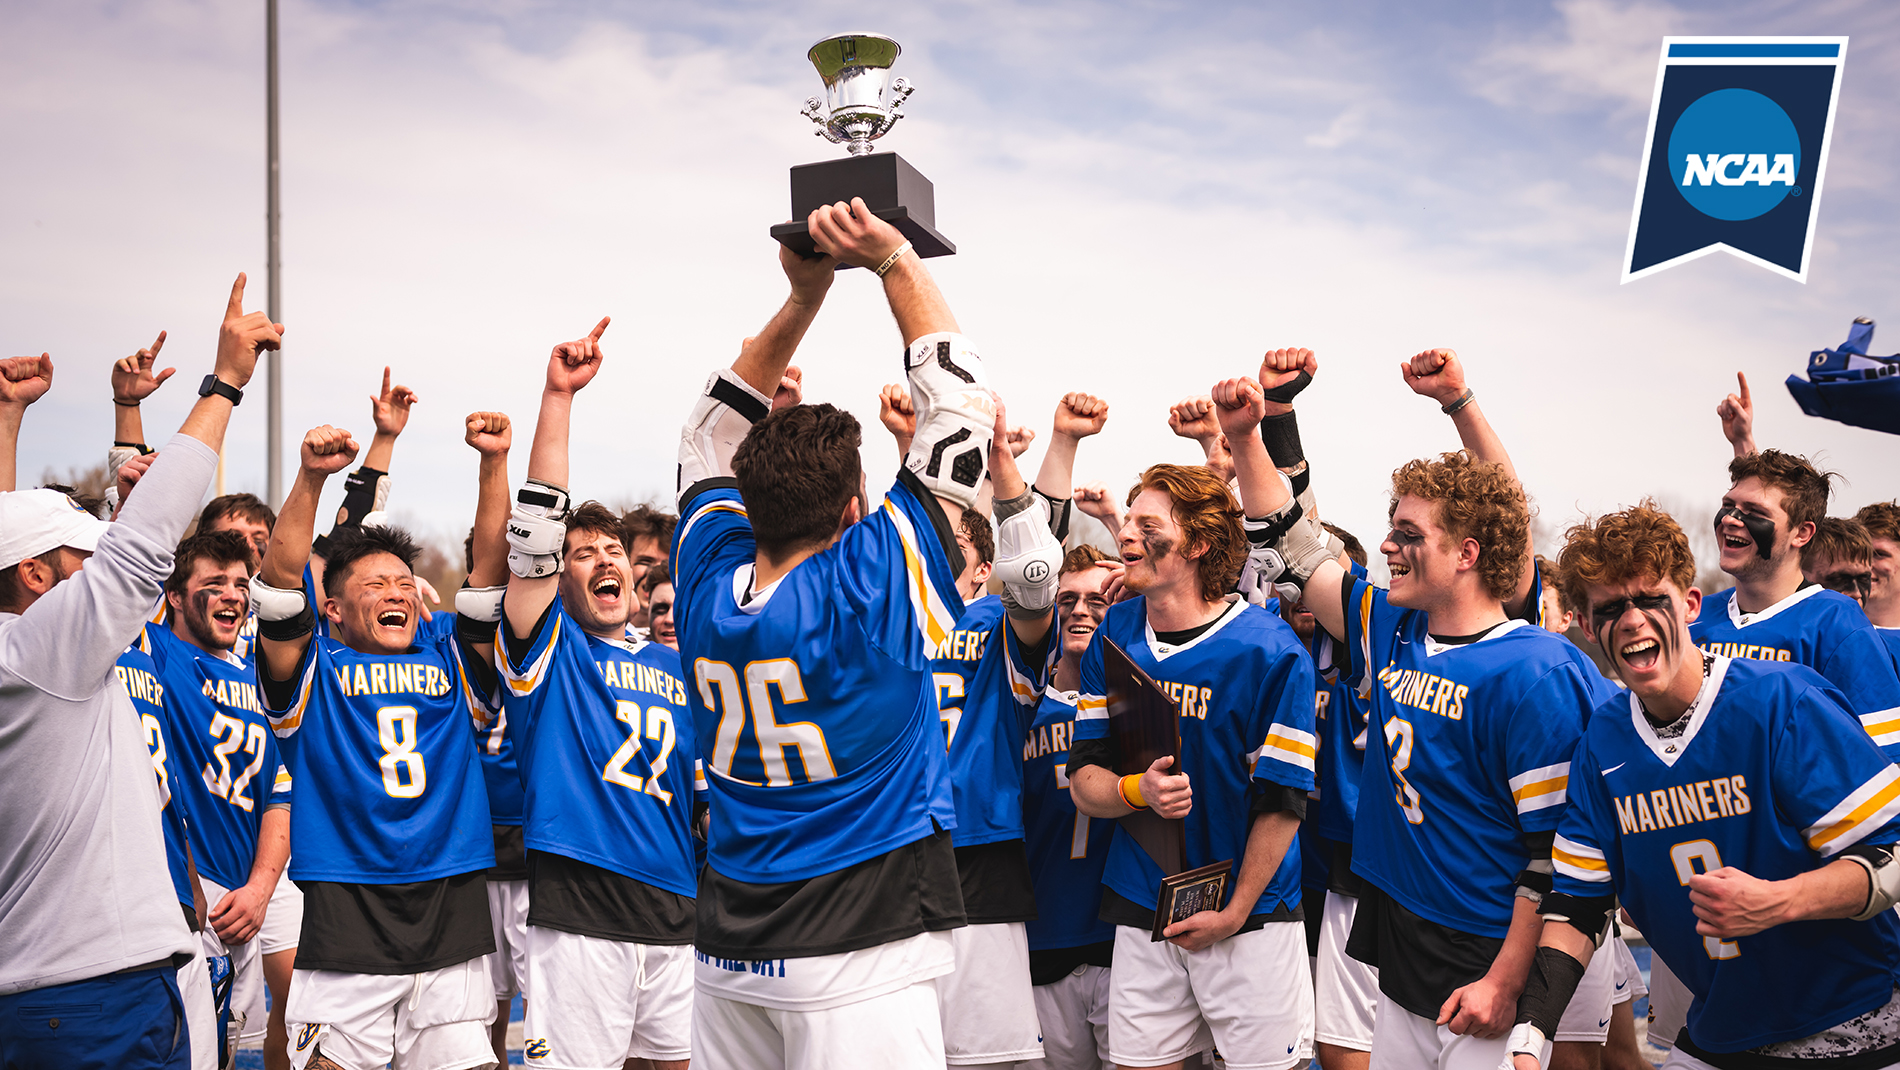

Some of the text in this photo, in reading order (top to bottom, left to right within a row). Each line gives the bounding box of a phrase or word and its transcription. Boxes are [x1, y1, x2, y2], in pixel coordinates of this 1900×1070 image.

[509, 524, 532, 539] STX
[334, 662, 452, 697] MARINERS
[595, 660, 687, 707] ARINERS
[376, 705, 427, 799] 8
[602, 699, 674, 807] 22
[694, 656, 838, 788] 26
[202, 710, 267, 813] 32
[1613, 774, 1752, 835] MARINERS
